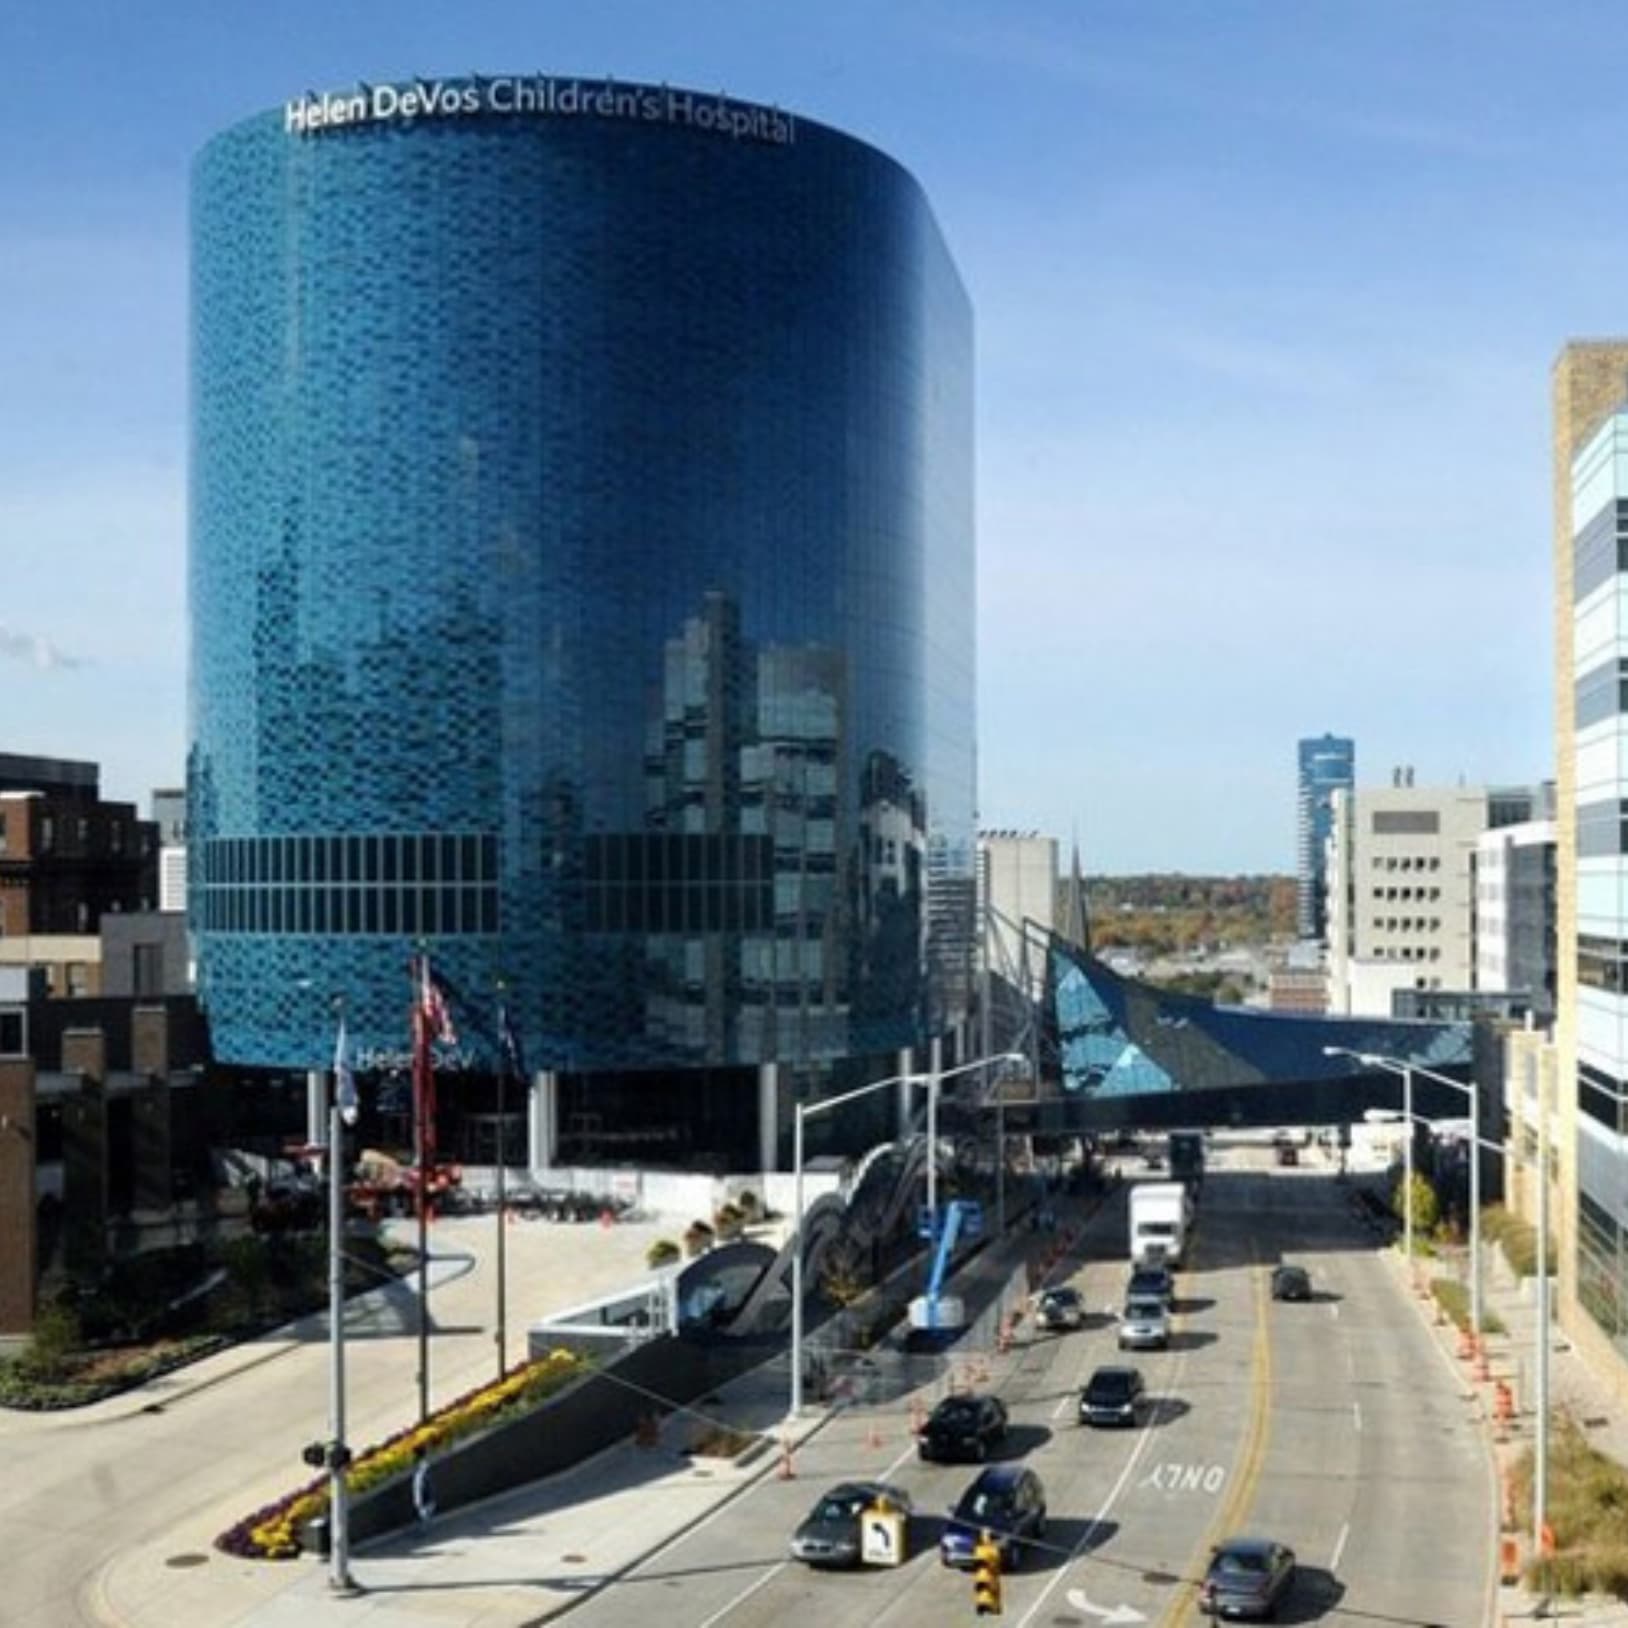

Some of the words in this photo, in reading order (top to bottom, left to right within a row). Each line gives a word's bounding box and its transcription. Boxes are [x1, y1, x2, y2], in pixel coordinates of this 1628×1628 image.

[284, 94, 366, 133] Helen
[373, 83, 479, 118] DeVos
[487, 79, 659, 120] Children's
[667, 91, 796, 144] Hospital
[1138, 1463, 1225, 1492] ONLY
